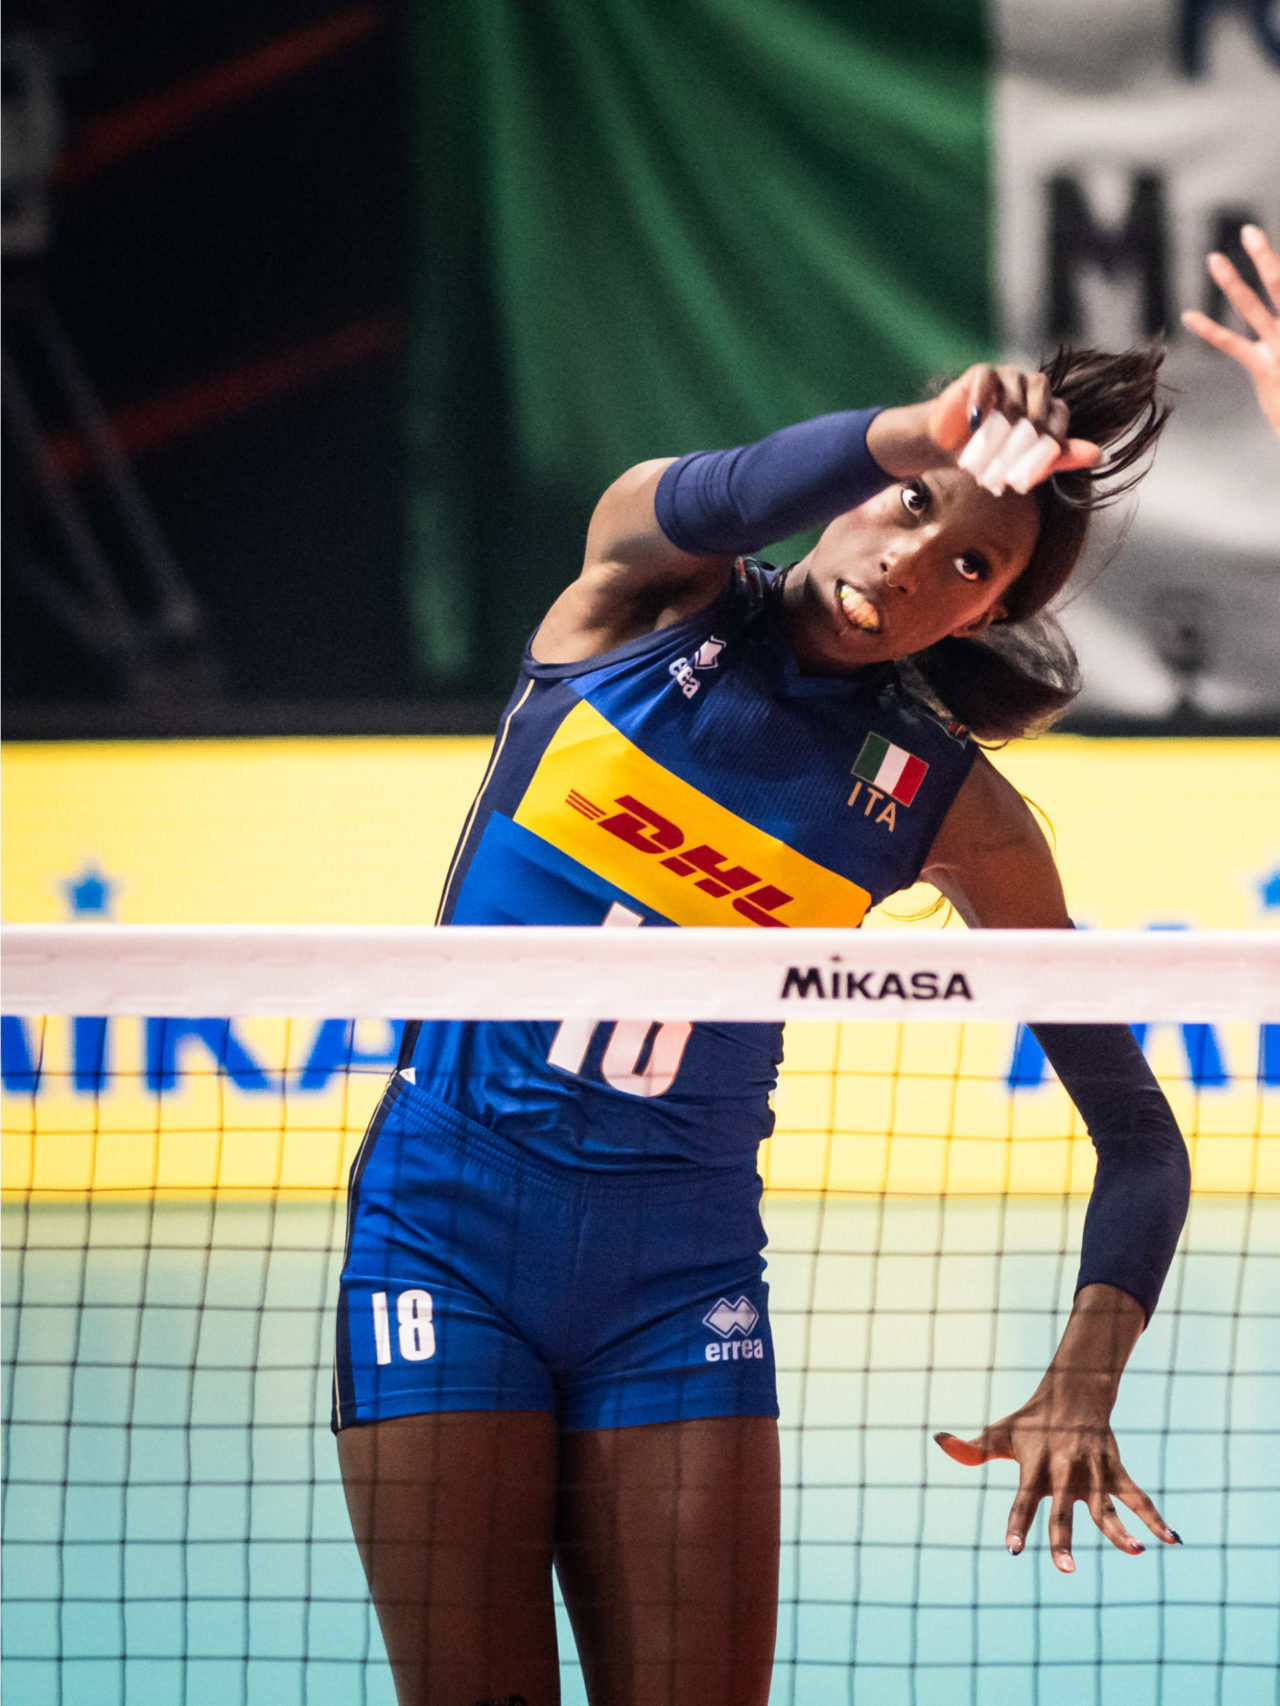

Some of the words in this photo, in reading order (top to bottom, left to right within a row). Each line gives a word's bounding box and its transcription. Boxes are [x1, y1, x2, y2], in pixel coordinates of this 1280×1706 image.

[847, 781, 897, 833] ITA
[597, 795, 794, 928] DHL
[780, 957, 974, 1000] MIKASA
[372, 1289, 436, 1365] 18
[705, 1338, 764, 1361] errea
